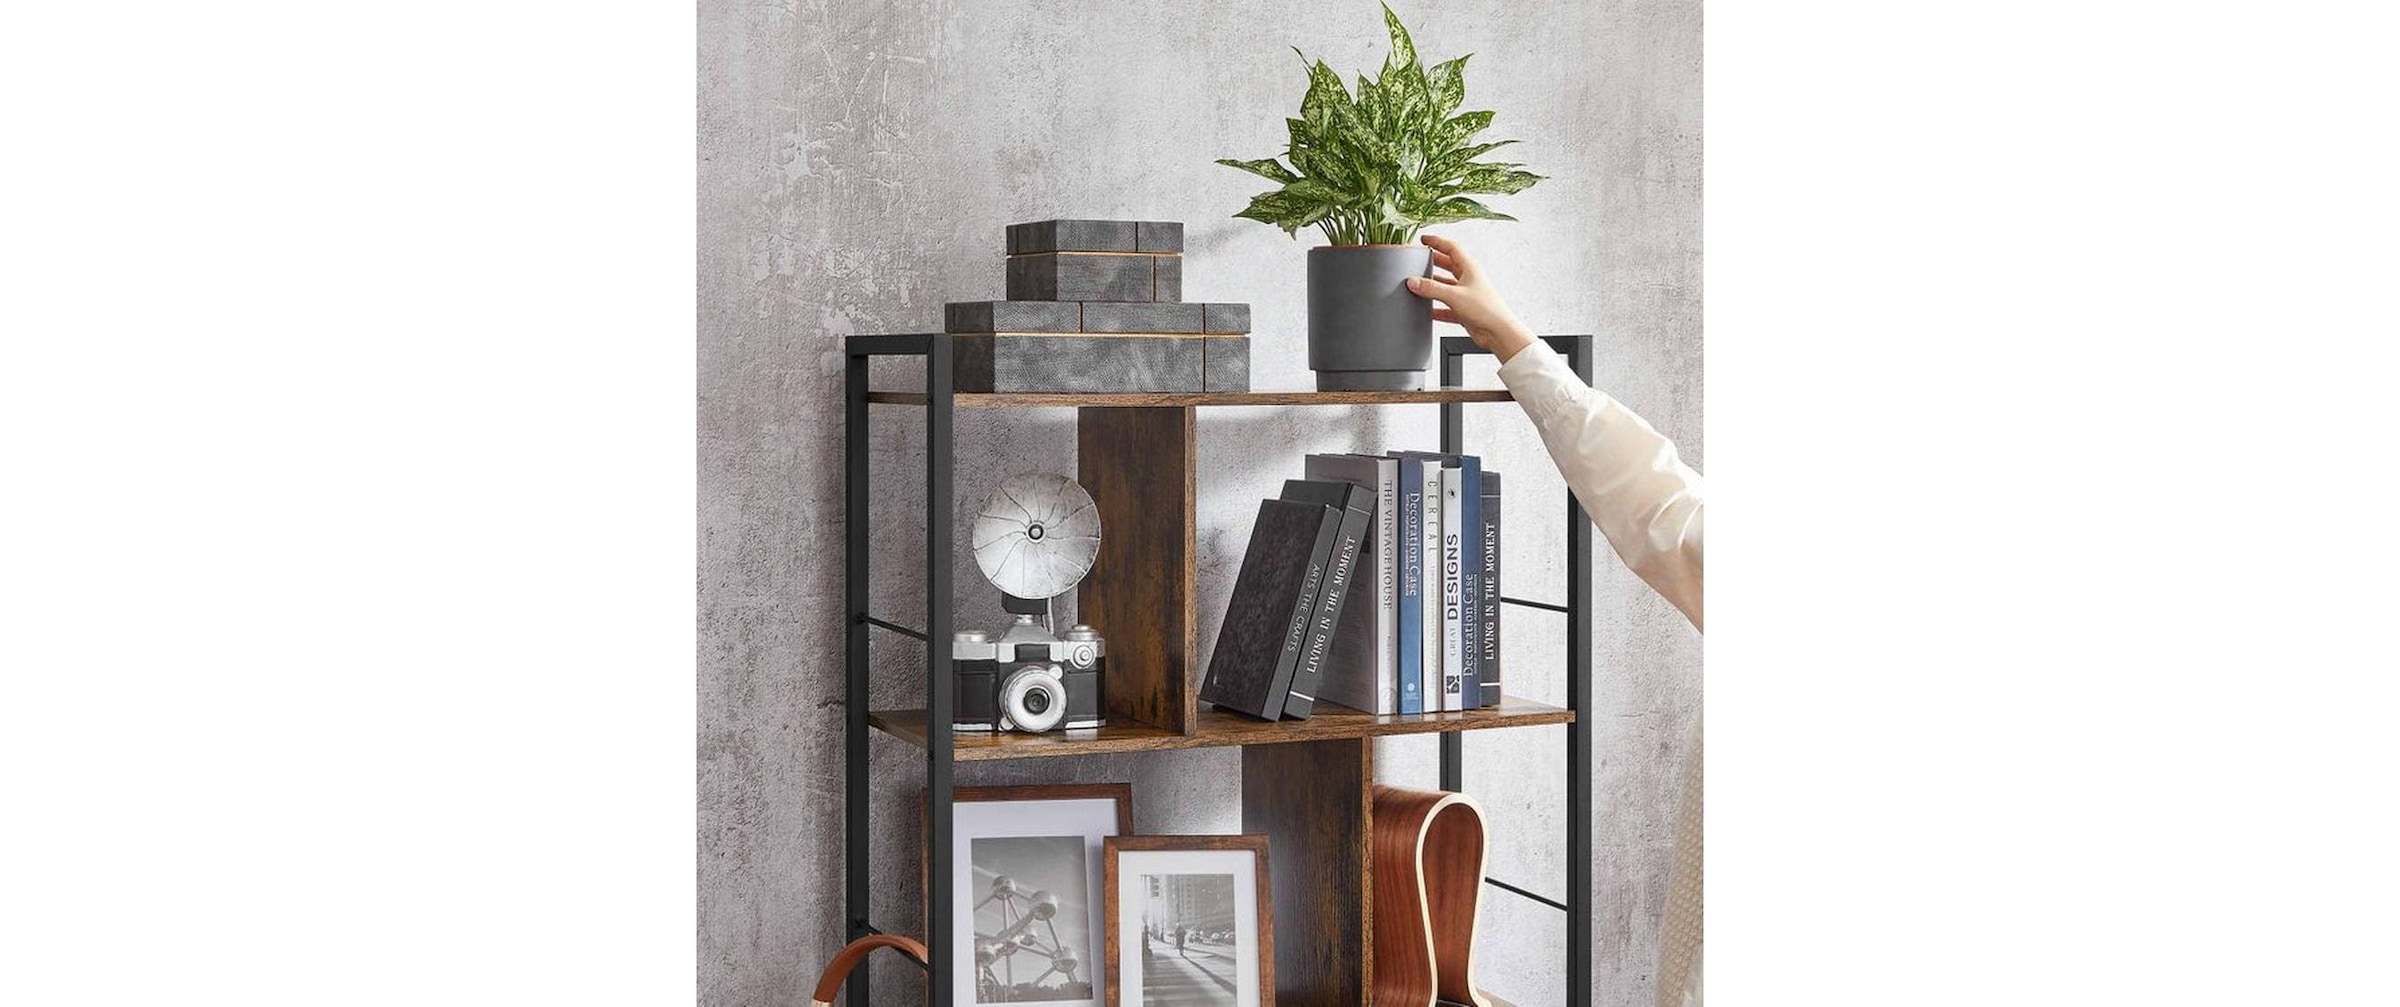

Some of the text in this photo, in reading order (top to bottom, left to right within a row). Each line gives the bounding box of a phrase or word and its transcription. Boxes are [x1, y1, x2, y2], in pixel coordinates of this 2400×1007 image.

[1382, 480, 1393, 610] THE VINTAGE HOUSE
[1409, 492, 1420, 597] Decoration Case
[1427, 480, 1439, 553] CEREAL
[1287, 563, 1320, 652] ARTS THE CRAFTS
[1306, 535, 1356, 673] LIVING IN THE MOMENT
[1446, 533, 1459, 620] DESIGNS
[1462, 573, 1474, 677] Decoration Case
[1485, 522, 1495, 660] LIVING IN THE MOMENT
